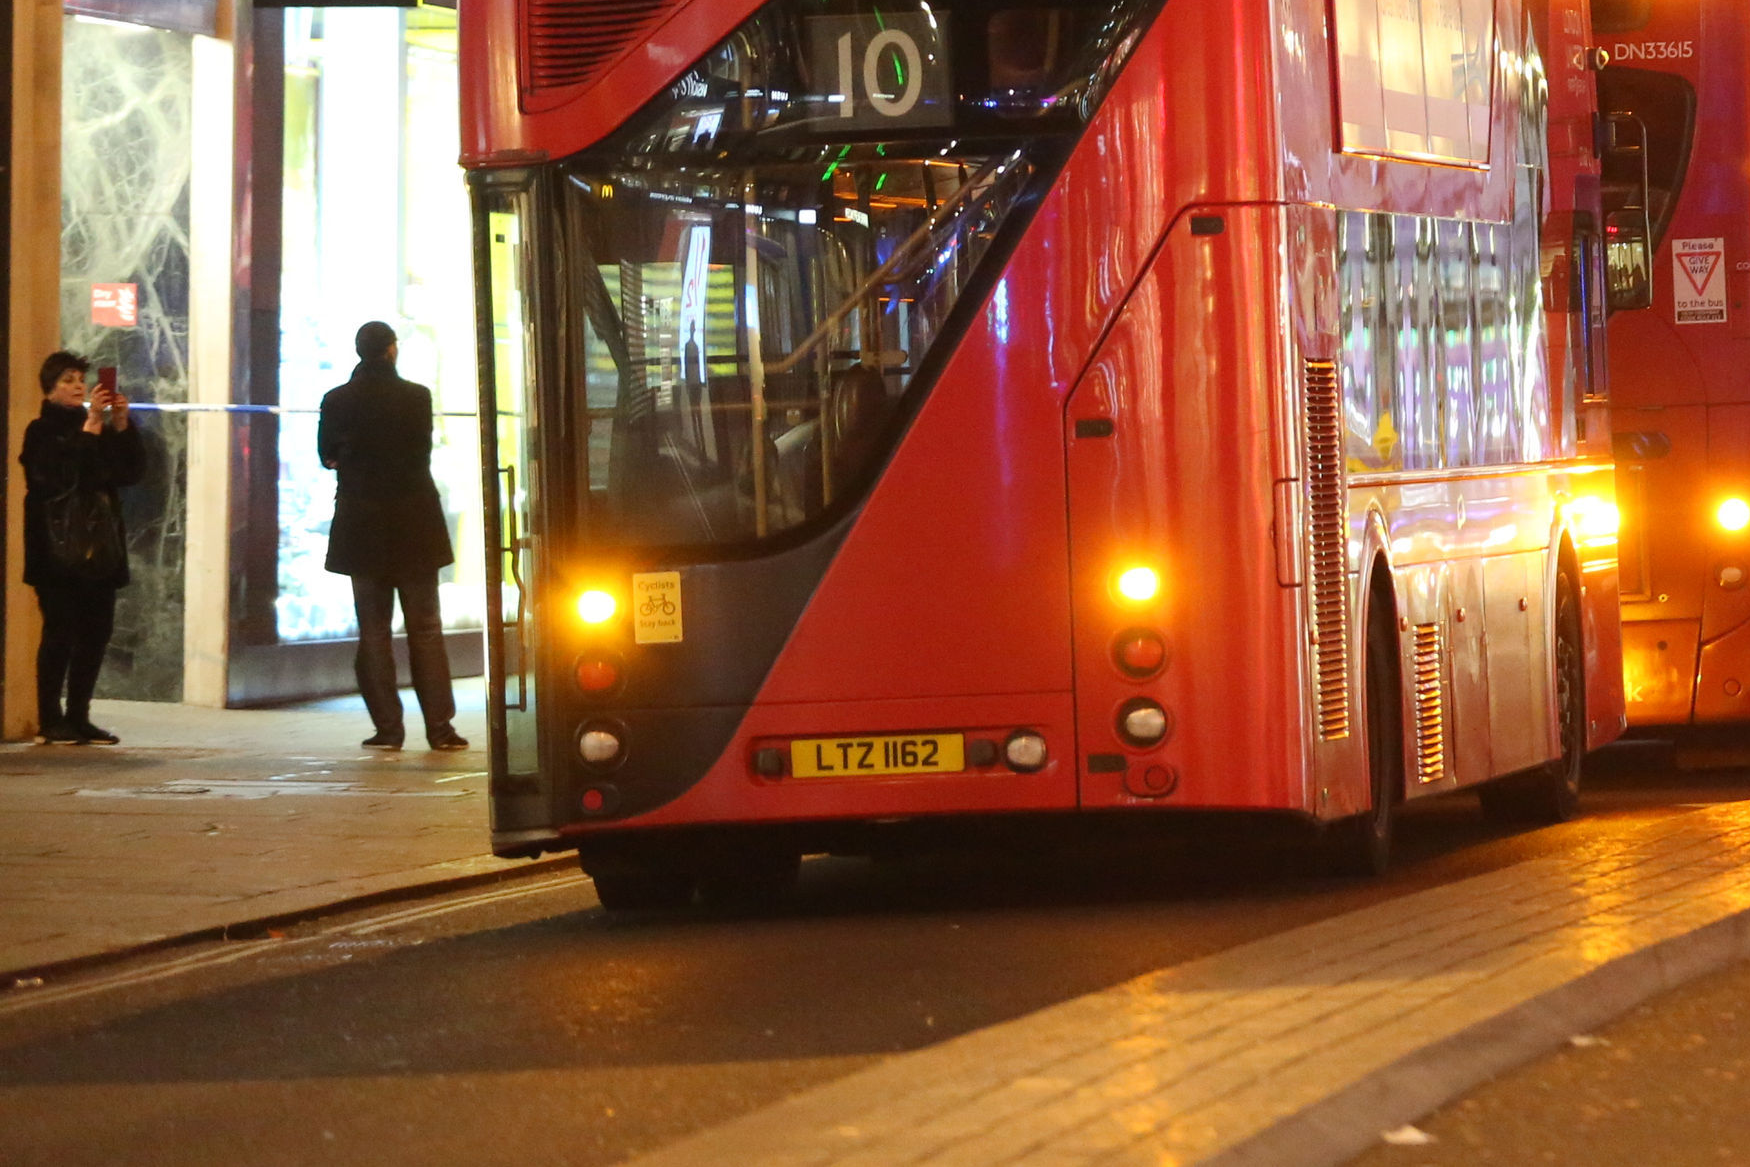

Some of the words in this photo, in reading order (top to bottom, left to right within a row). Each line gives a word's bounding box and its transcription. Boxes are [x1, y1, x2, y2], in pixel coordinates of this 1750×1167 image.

[1614, 41, 1693, 61] DN33615
[838, 28, 923, 118] 10
[1682, 241, 1714, 251] Please
[1689, 256, 1710, 265] GIVE
[1689, 265, 1710, 275] WAY
[1678, 300, 1687, 309] to
[1689, 299, 1706, 308] the
[1707, 298, 1724, 308] bus
[638, 581, 675, 592] Cyclists
[816, 741, 876, 772] LTZ
[884, 739, 940, 769] 1162
